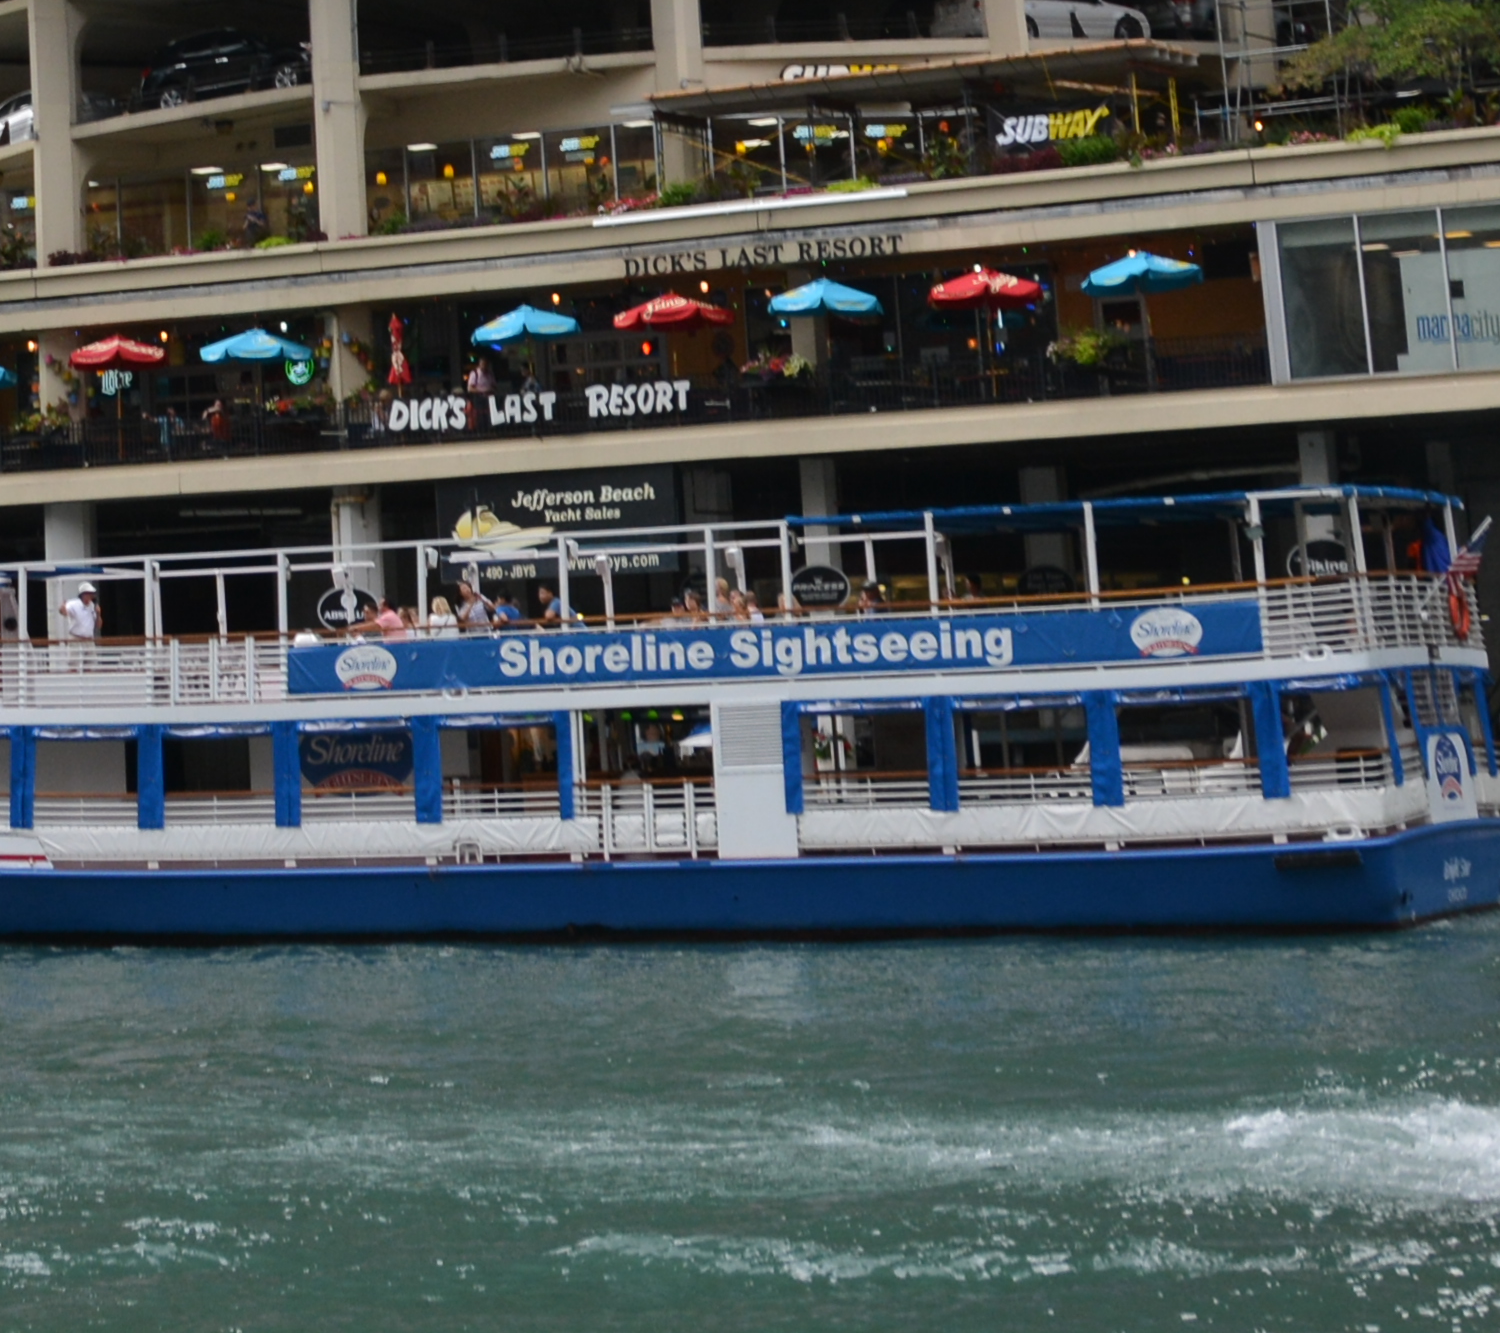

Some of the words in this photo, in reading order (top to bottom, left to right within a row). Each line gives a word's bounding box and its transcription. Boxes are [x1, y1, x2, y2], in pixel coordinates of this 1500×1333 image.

[995, 104, 1109, 147] SUBWAY
[624, 251, 706, 277] DICK'S
[720, 245, 785, 268] LAST
[798, 235, 903, 262] RESORT
[388, 395, 467, 432] DICK'S
[488, 391, 556, 426] LAST
[584, 380, 690, 418] RESORT
[511, 489, 595, 511] Jefferson
[600, 482, 655, 503] Beach
[544, 508, 581, 523] Yacht
[585, 506, 621, 521] Sales
[499, 634, 715, 677] Shoreline
[729, 622, 1014, 676] Sightseeing
[306, 734, 405, 765] Shoreline
